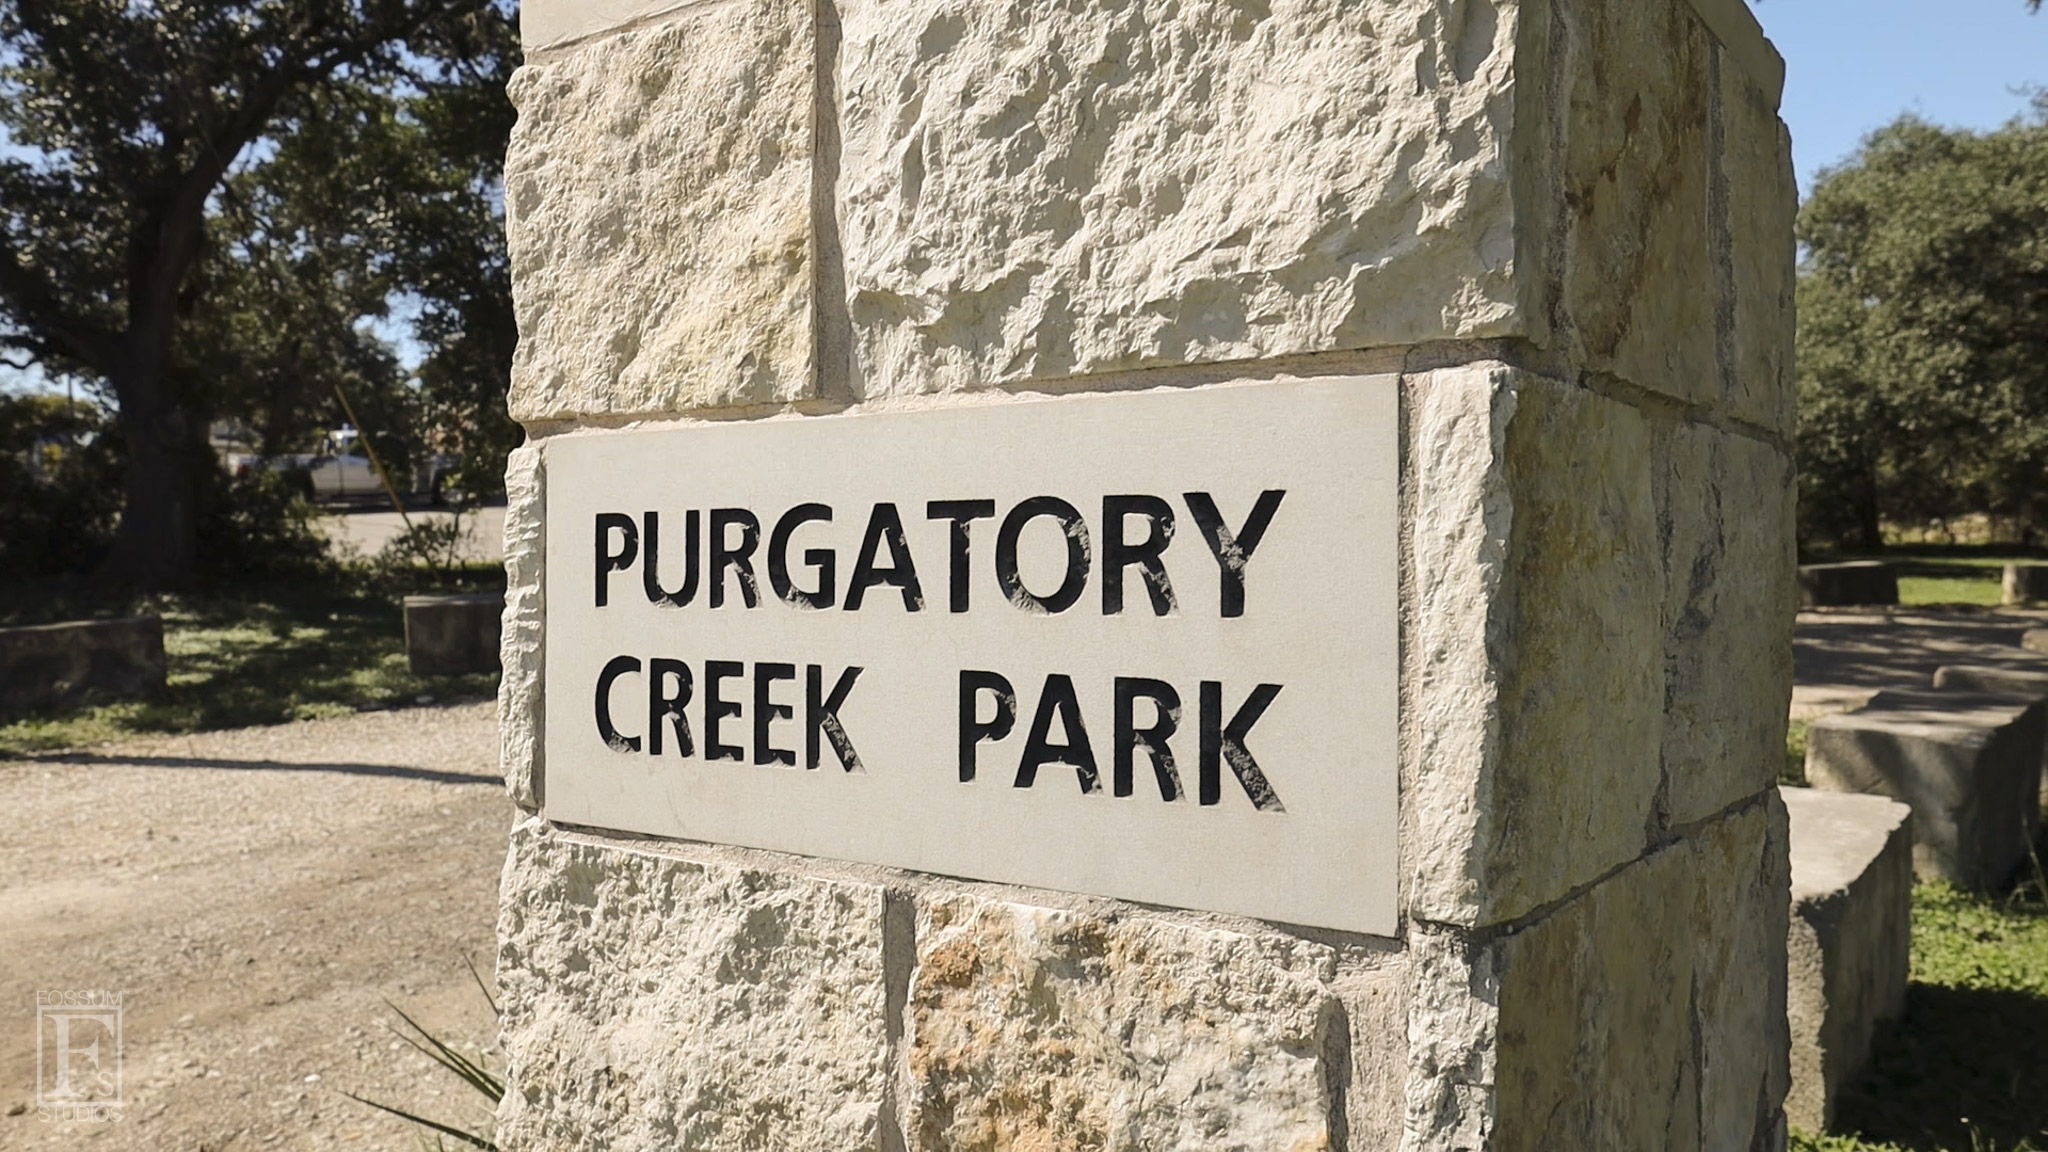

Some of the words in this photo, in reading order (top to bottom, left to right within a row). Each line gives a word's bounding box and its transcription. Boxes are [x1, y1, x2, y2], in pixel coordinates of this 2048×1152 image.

[595, 489, 1287, 618] PURGATORY
[595, 655, 865, 773] CREEK
[958, 669, 1285, 811] PARK
